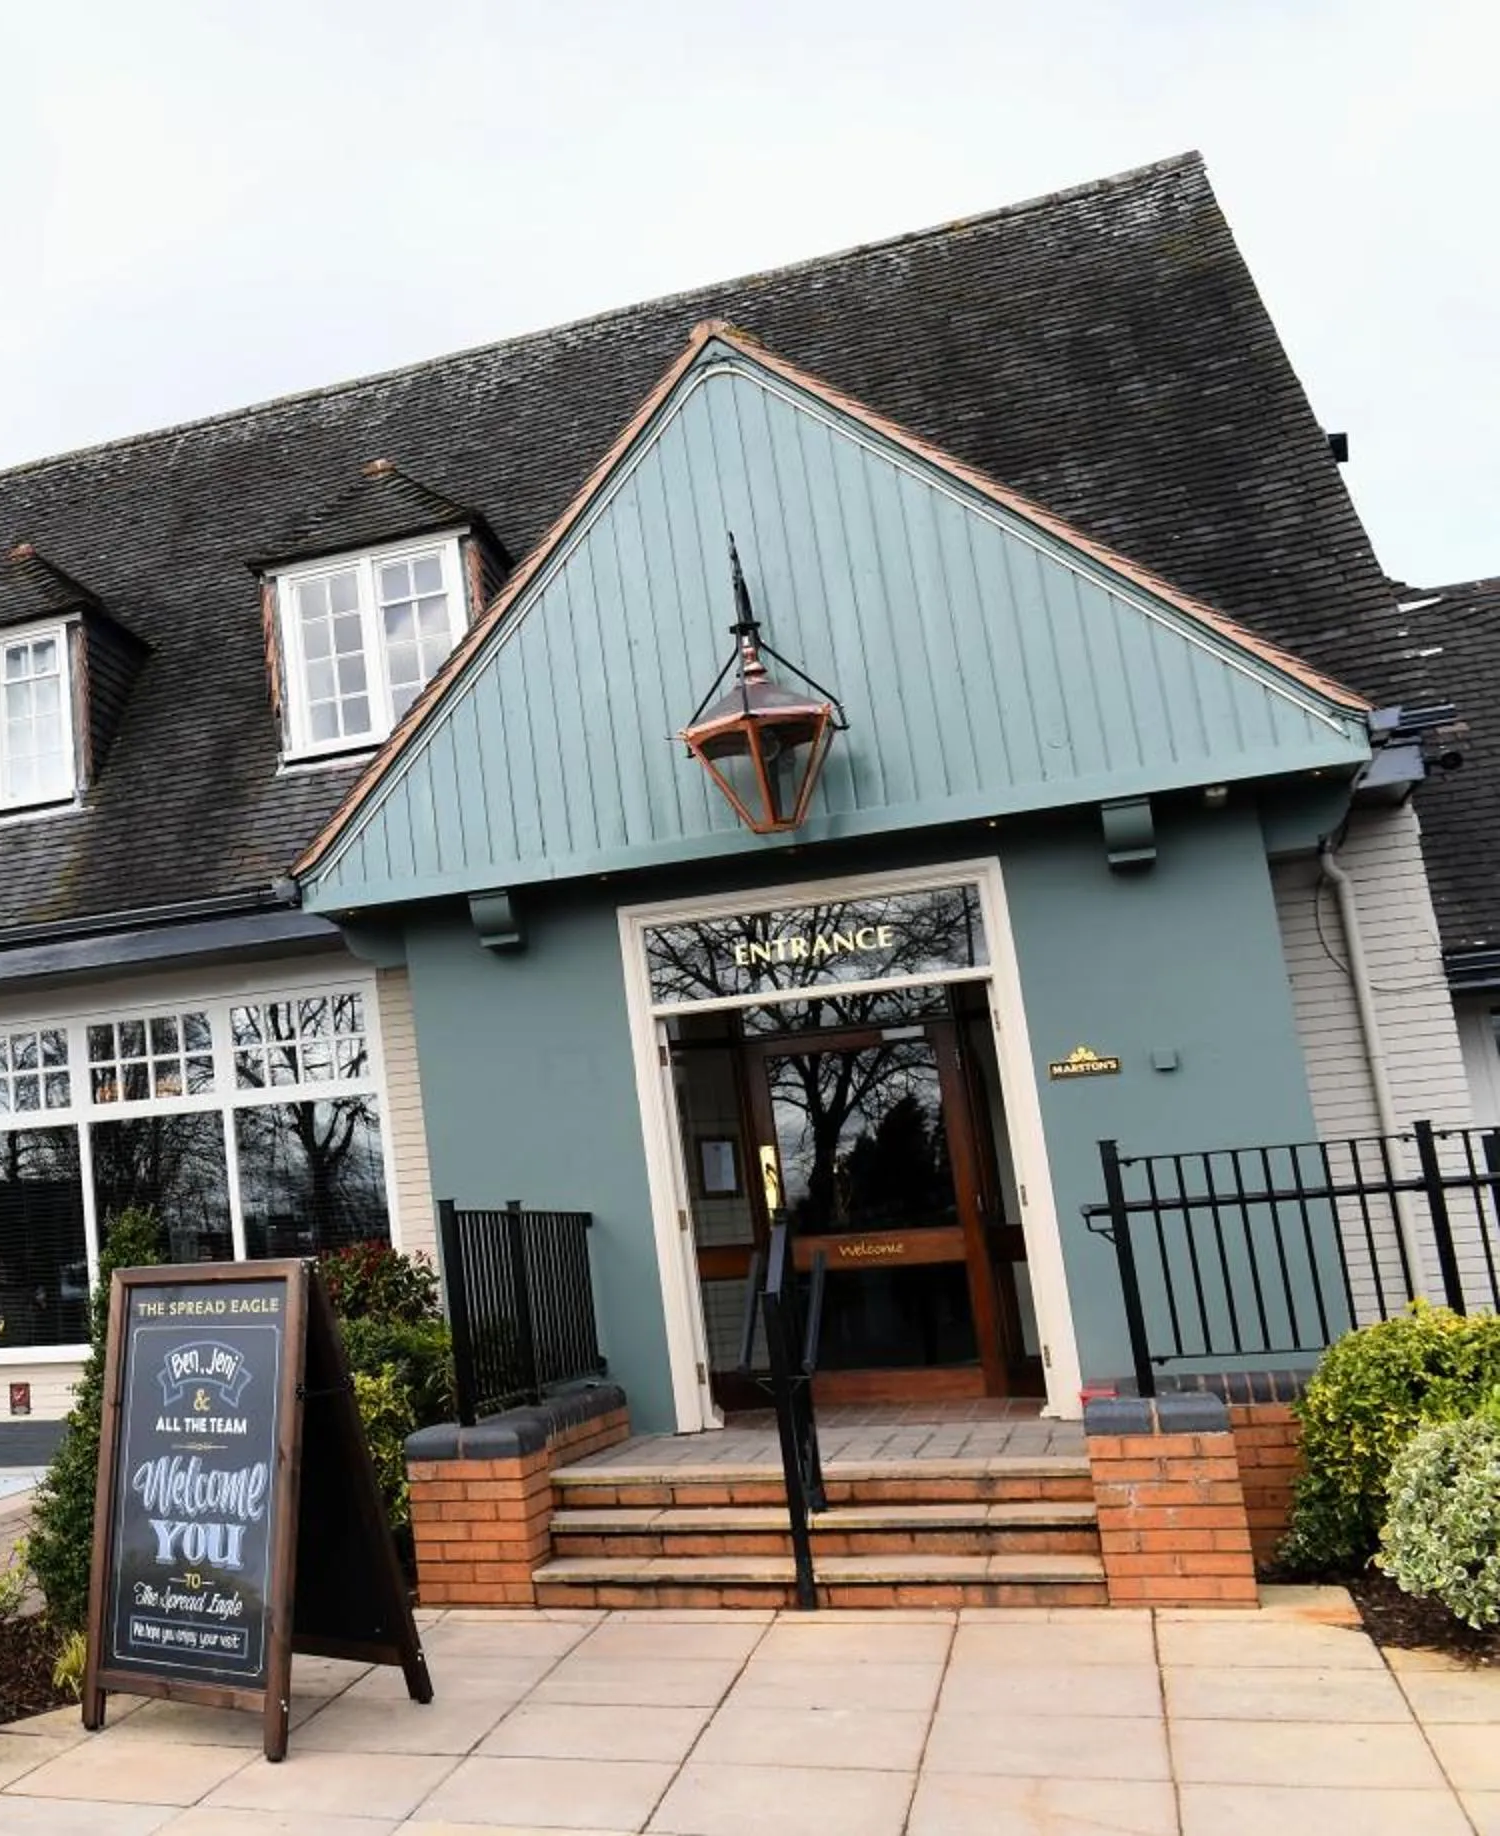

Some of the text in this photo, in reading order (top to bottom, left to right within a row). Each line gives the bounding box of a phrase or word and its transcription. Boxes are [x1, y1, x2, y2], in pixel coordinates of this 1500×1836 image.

[734, 925, 895, 966] ENTRANCE
[1052, 1060, 1117, 1075] MARSTON'S
[138, 1298, 279, 1317] THE SPREAD EAGLE
[193, 1387, 210, 1412] &
[155, 1416, 248, 1435] ALL THE TEAM
[132, 1455, 268, 1521] Welcome
[148, 1519, 248, 1570] YOU
[184, 1572, 201, 1589] TO
[133, 1581, 243, 1620] The Spread Eagle
[161, 1627, 175, 1645] you
[199, 1632, 219, 1649] your
